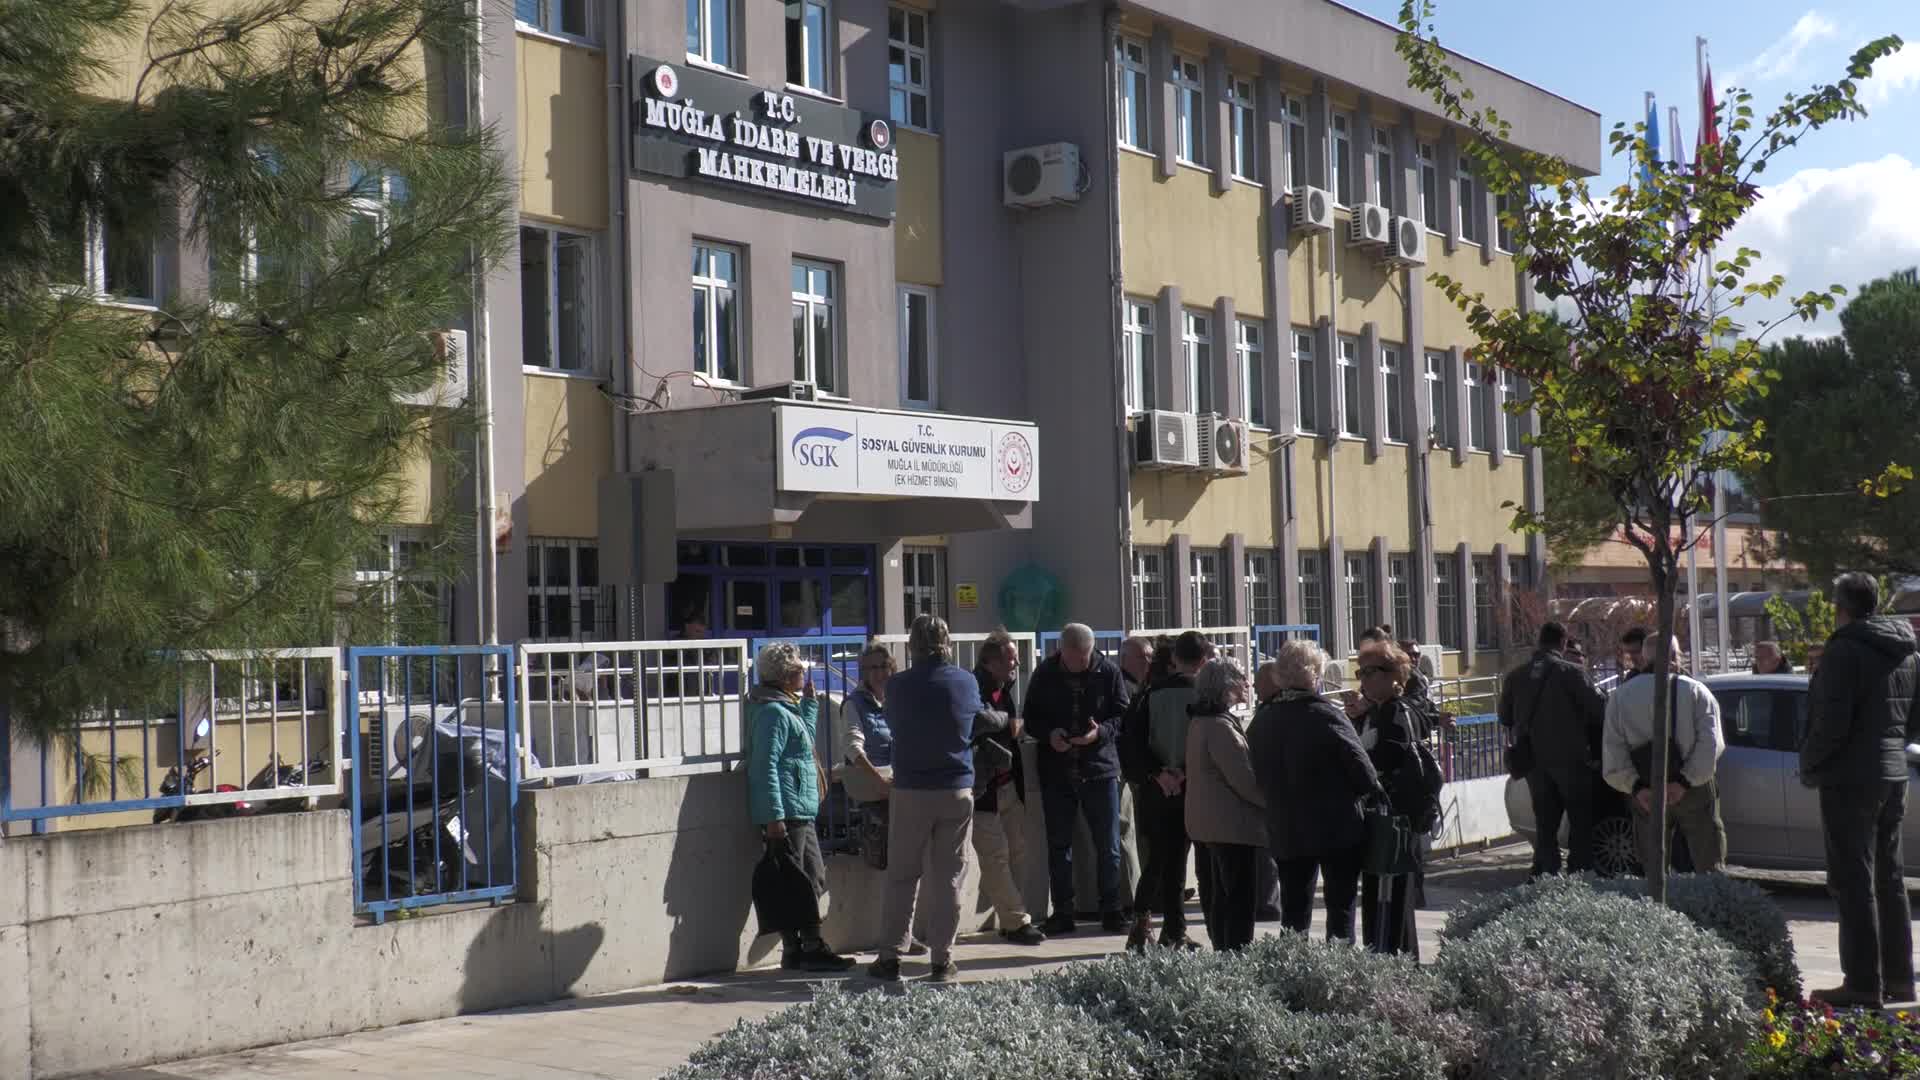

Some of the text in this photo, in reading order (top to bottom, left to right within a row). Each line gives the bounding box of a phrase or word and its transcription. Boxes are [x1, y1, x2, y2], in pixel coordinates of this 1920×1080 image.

[764, 91, 802, 123] T.C.
[645, 97, 898, 181] MUĞLA İDARE VE VERGİ
[698, 147, 856, 205] MAHKEMELERİ
[917, 425, 935, 437] T.C.
[799, 443, 839, 467] SGK
[861, 438, 986, 458] SOSYAL GÜVENLİK KURUMU
[887, 458, 912, 471] MUĞLA
[921, 460, 963, 474] MÜDÜRLÜĞÜ
[895, 473, 958, 488] (EK HİZMET BİNASI)
